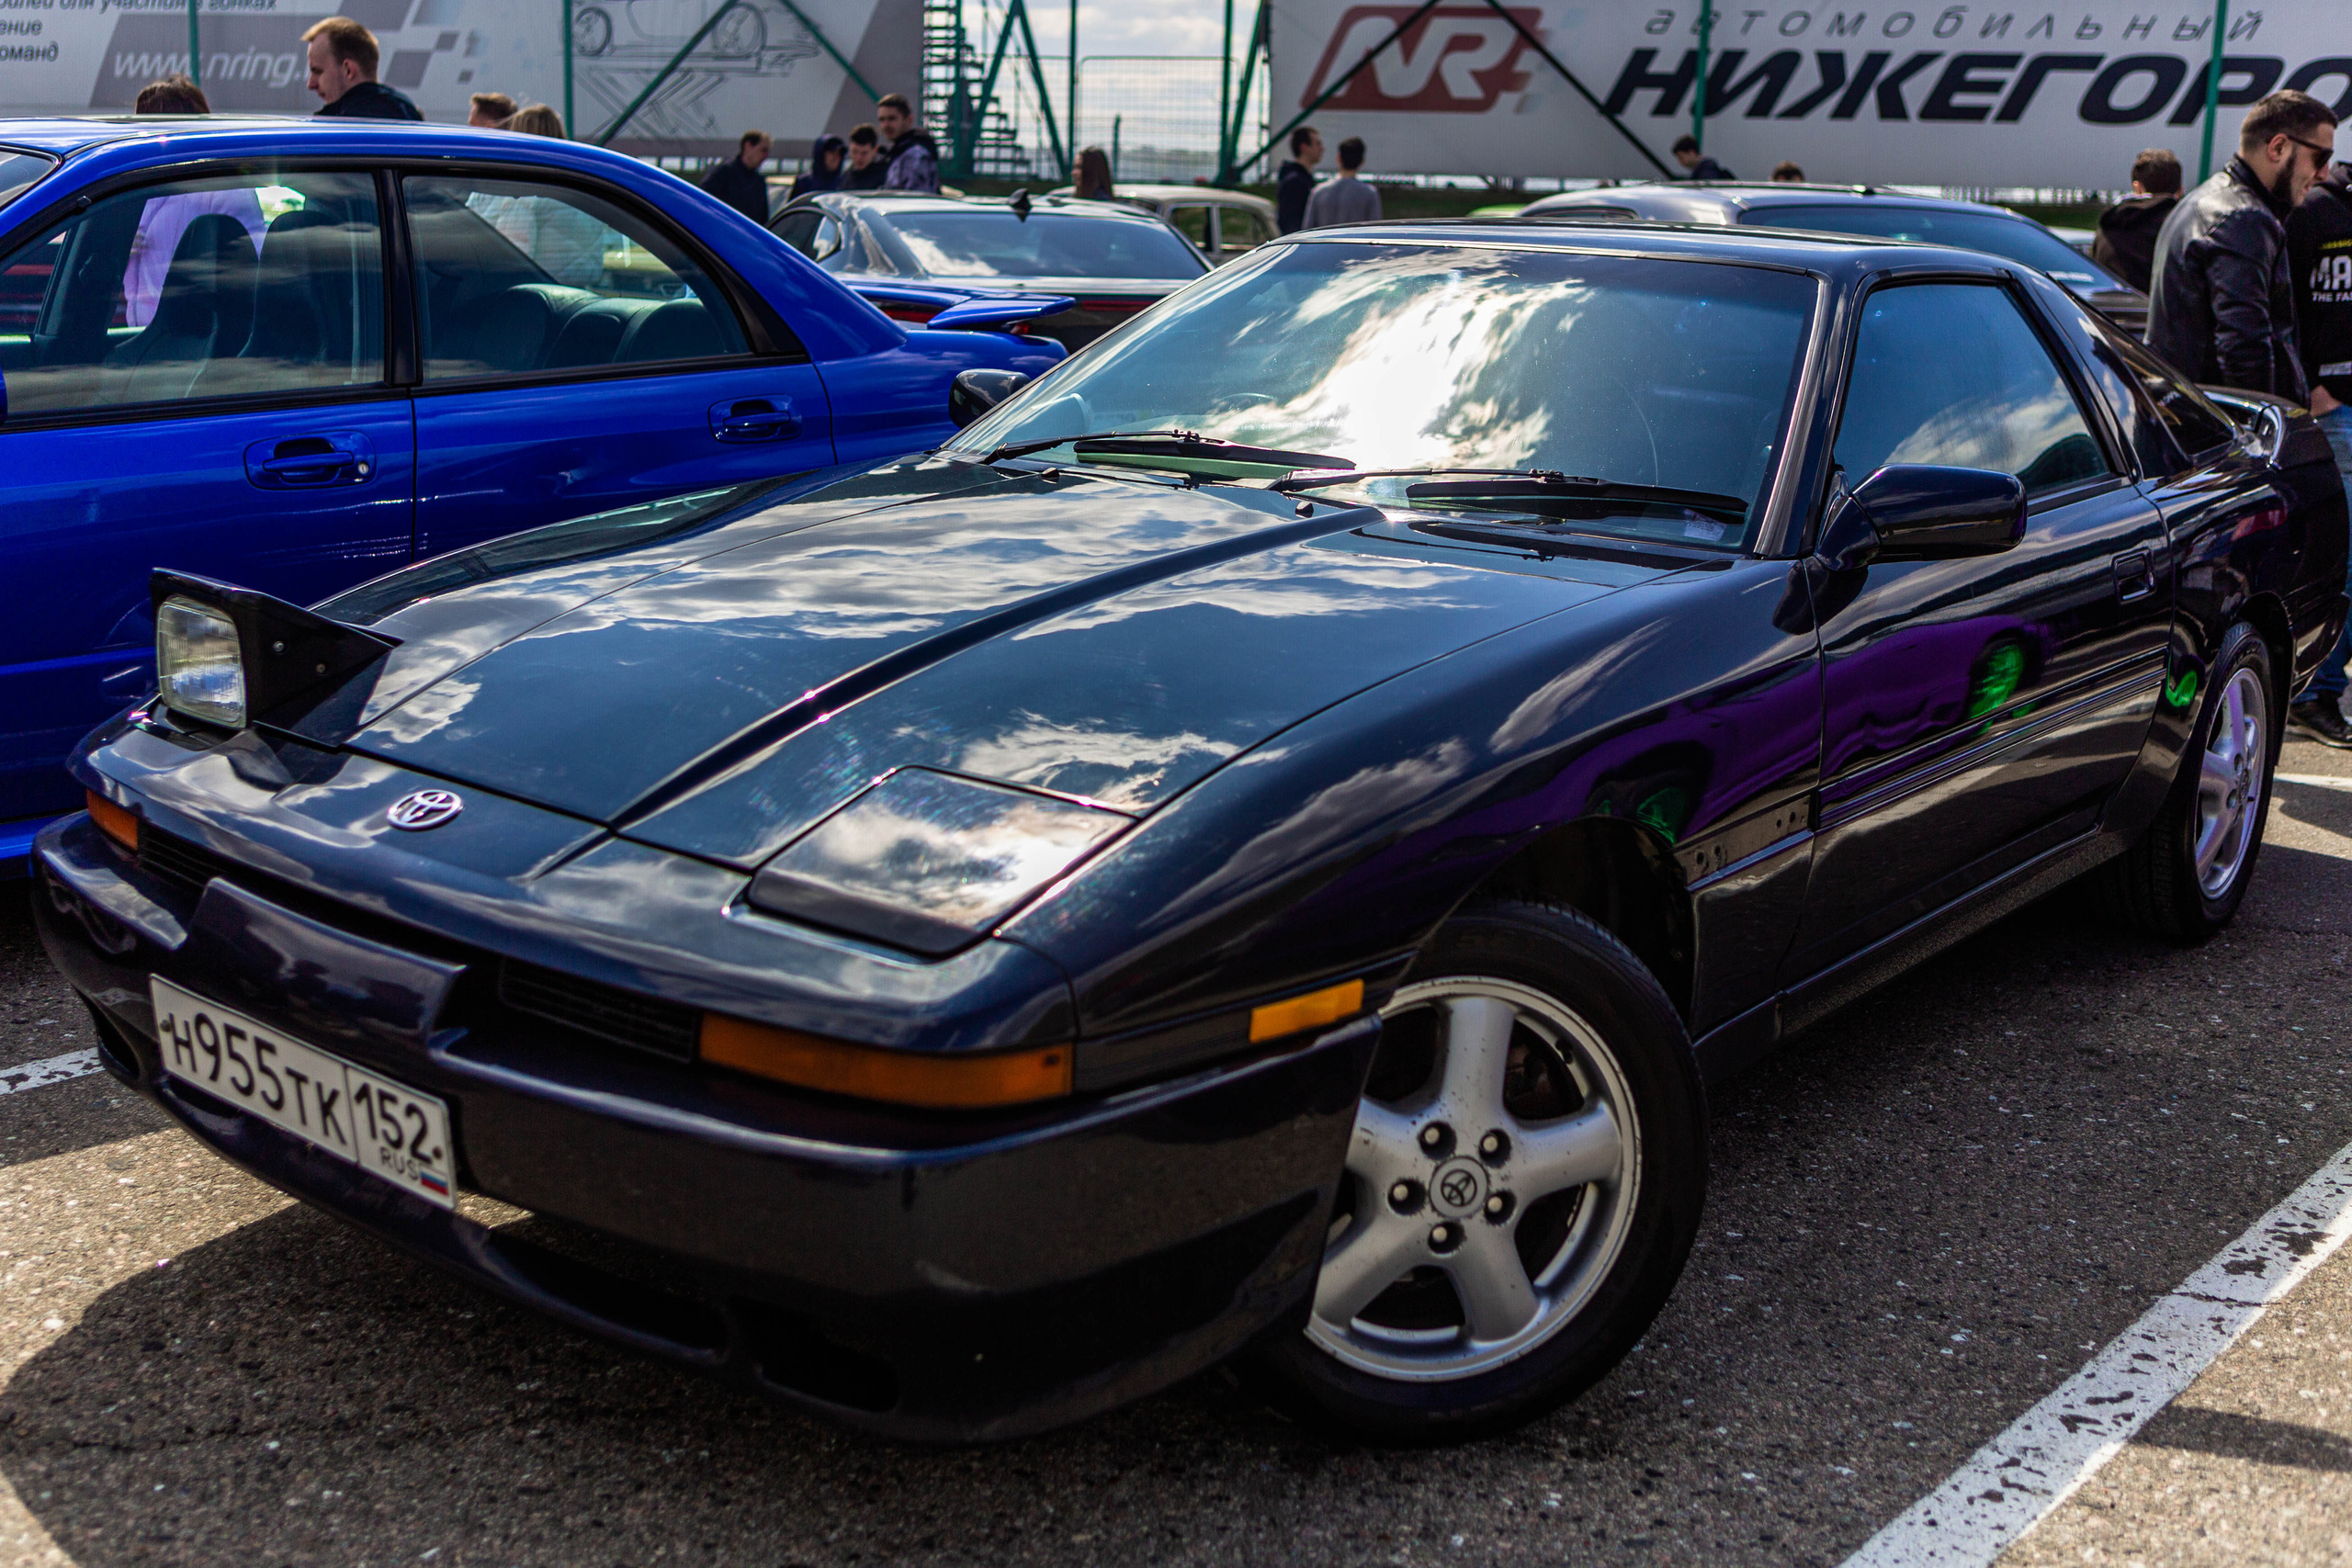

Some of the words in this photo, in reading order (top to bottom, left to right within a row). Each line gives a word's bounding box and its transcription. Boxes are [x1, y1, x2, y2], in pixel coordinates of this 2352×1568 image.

[1645, 9, 2263, 41] автомобильный
[2312, 291, 2333, 302] THE
[355, 1082, 433, 1165] 152
[379, 1145, 419, 1181] RUS
